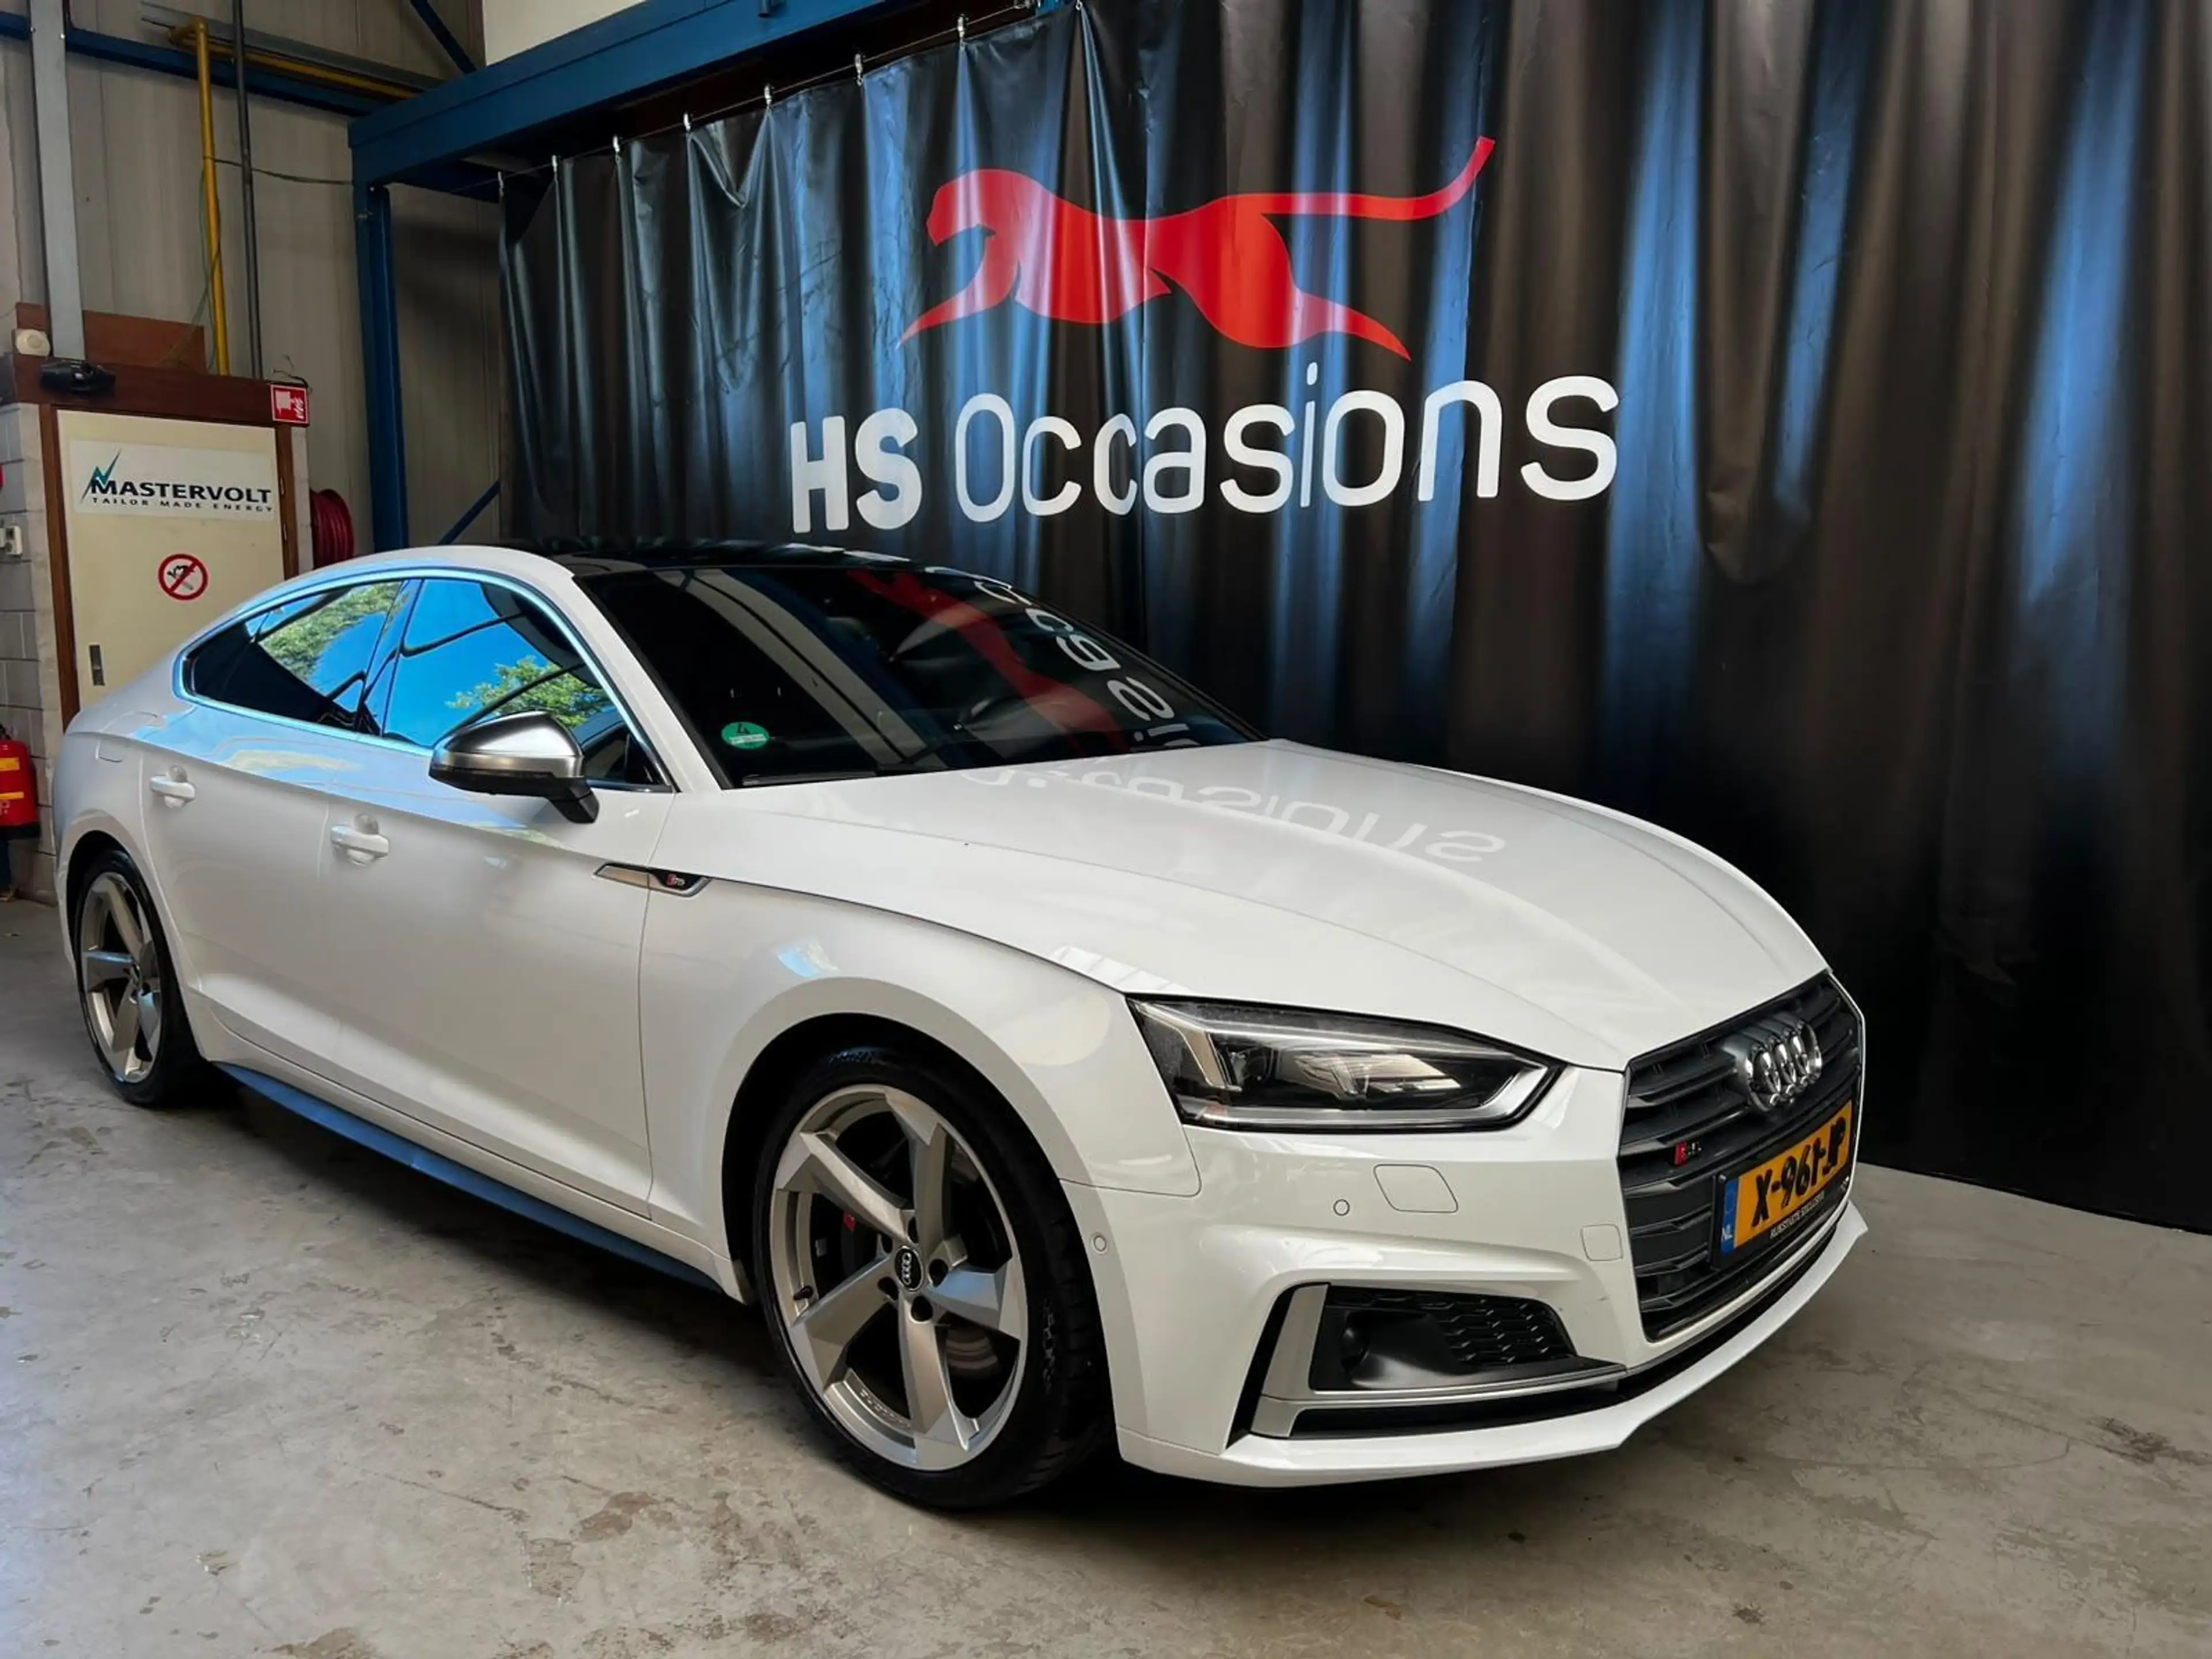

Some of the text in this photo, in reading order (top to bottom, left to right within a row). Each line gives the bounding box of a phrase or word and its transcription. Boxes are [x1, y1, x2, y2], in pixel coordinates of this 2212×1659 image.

[790, 361, 1619, 533] HS Occasions
[91, 479, 272, 503] MASTERVOLT
[92, 497, 272, 513] TAILOR MADE ENERGY
